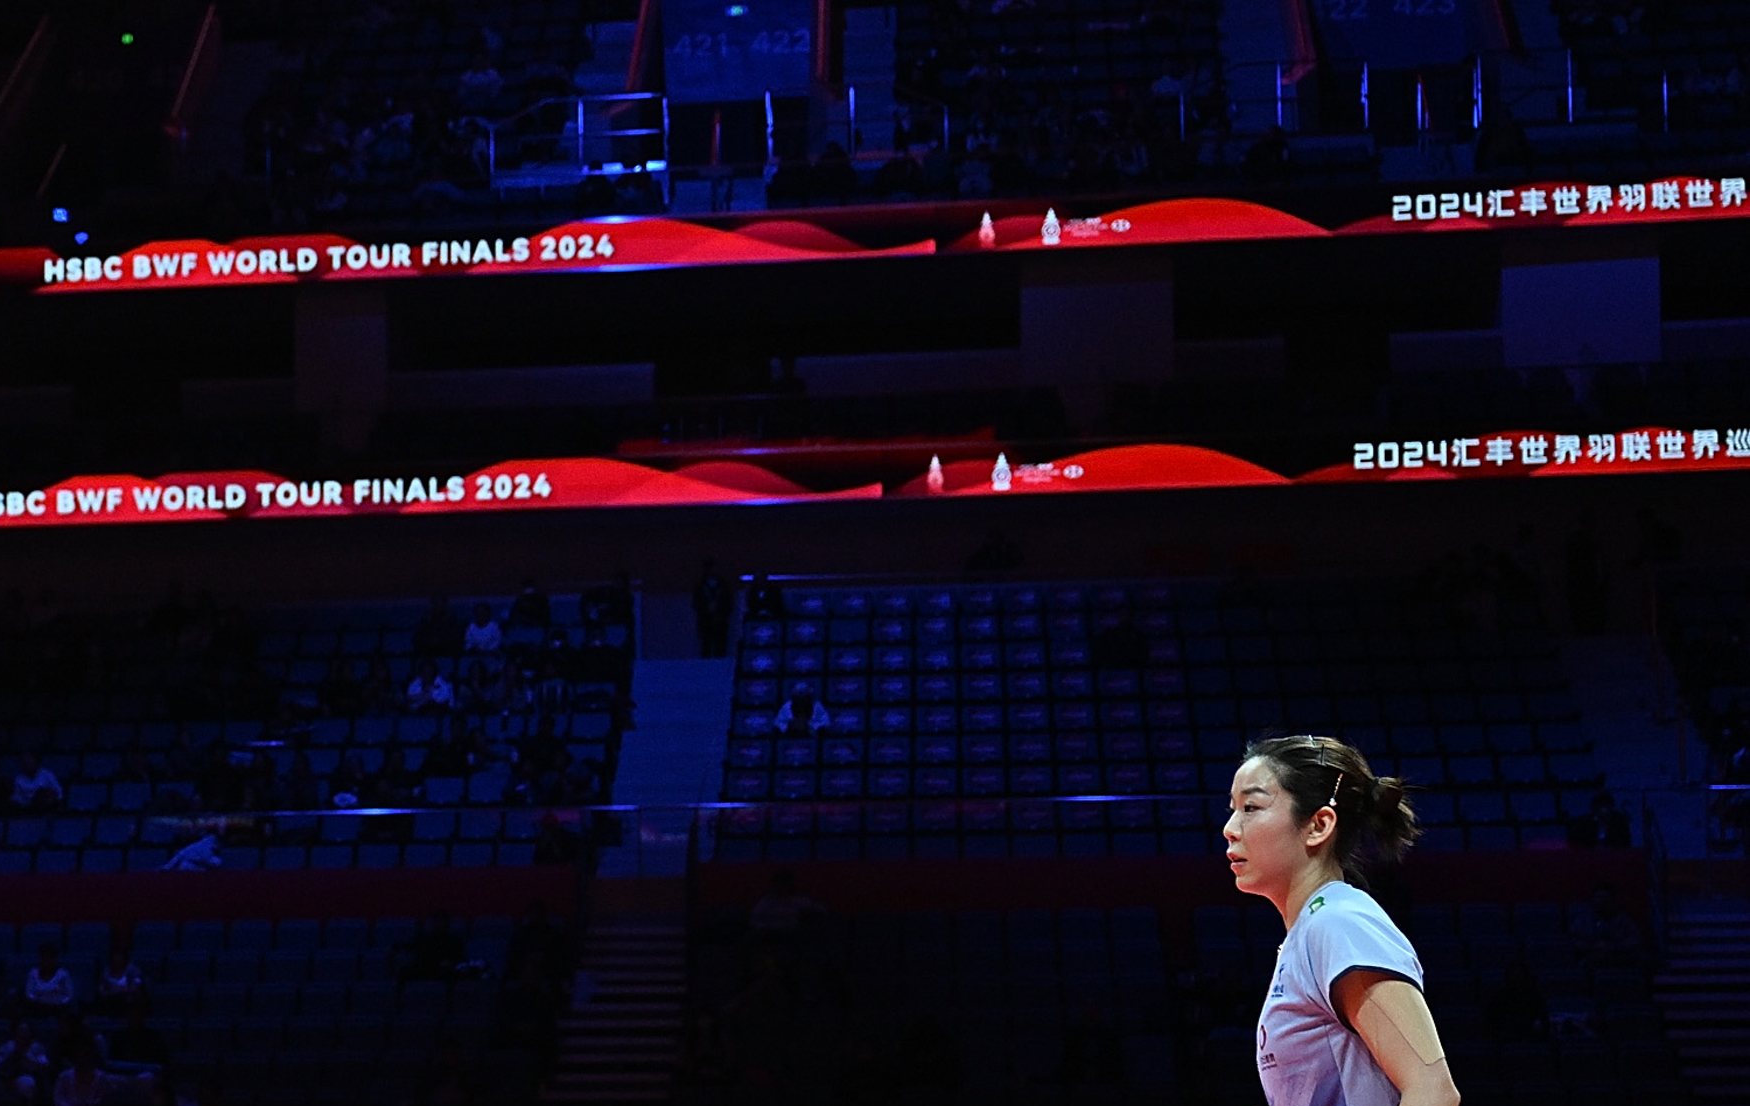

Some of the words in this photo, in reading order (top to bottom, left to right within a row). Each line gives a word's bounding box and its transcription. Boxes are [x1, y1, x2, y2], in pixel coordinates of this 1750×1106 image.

[43, 255, 124, 284] HSBC
[132, 251, 197, 278] BWF
[206, 246, 318, 276] WORLD
[326, 242, 412, 270] TOUR
[421, 237, 530, 266] FINALS
[538, 234, 615, 261] 2024
[56, 487, 124, 514] BWF
[133, 483, 248, 512] WORLD
[256, 480, 343, 508] TOUR
[353, 475, 466, 505] FINALS
[474, 473, 552, 500] 2024
